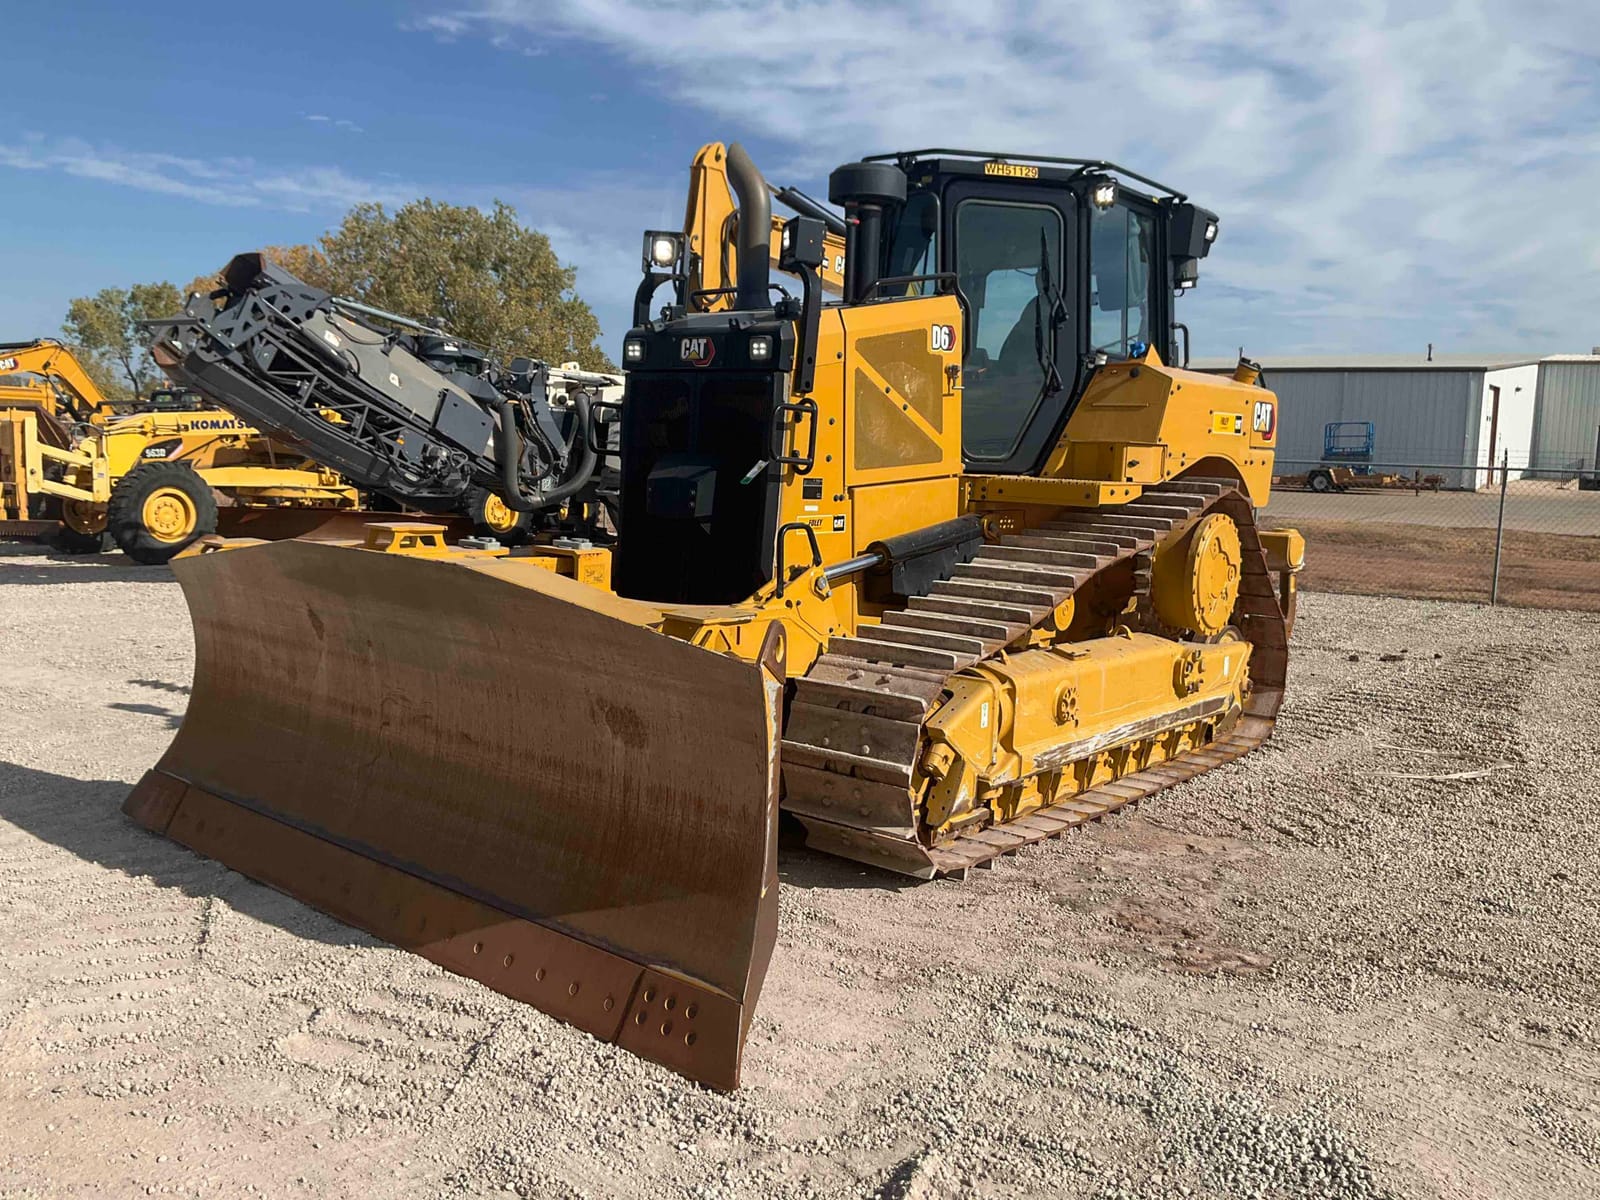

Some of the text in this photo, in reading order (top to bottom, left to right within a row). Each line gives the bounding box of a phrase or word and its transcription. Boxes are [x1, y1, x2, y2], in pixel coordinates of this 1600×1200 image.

[680, 338, 707, 360] CAT
[931, 324, 950, 351] D6
[1253, 402, 1273, 433] CAT
